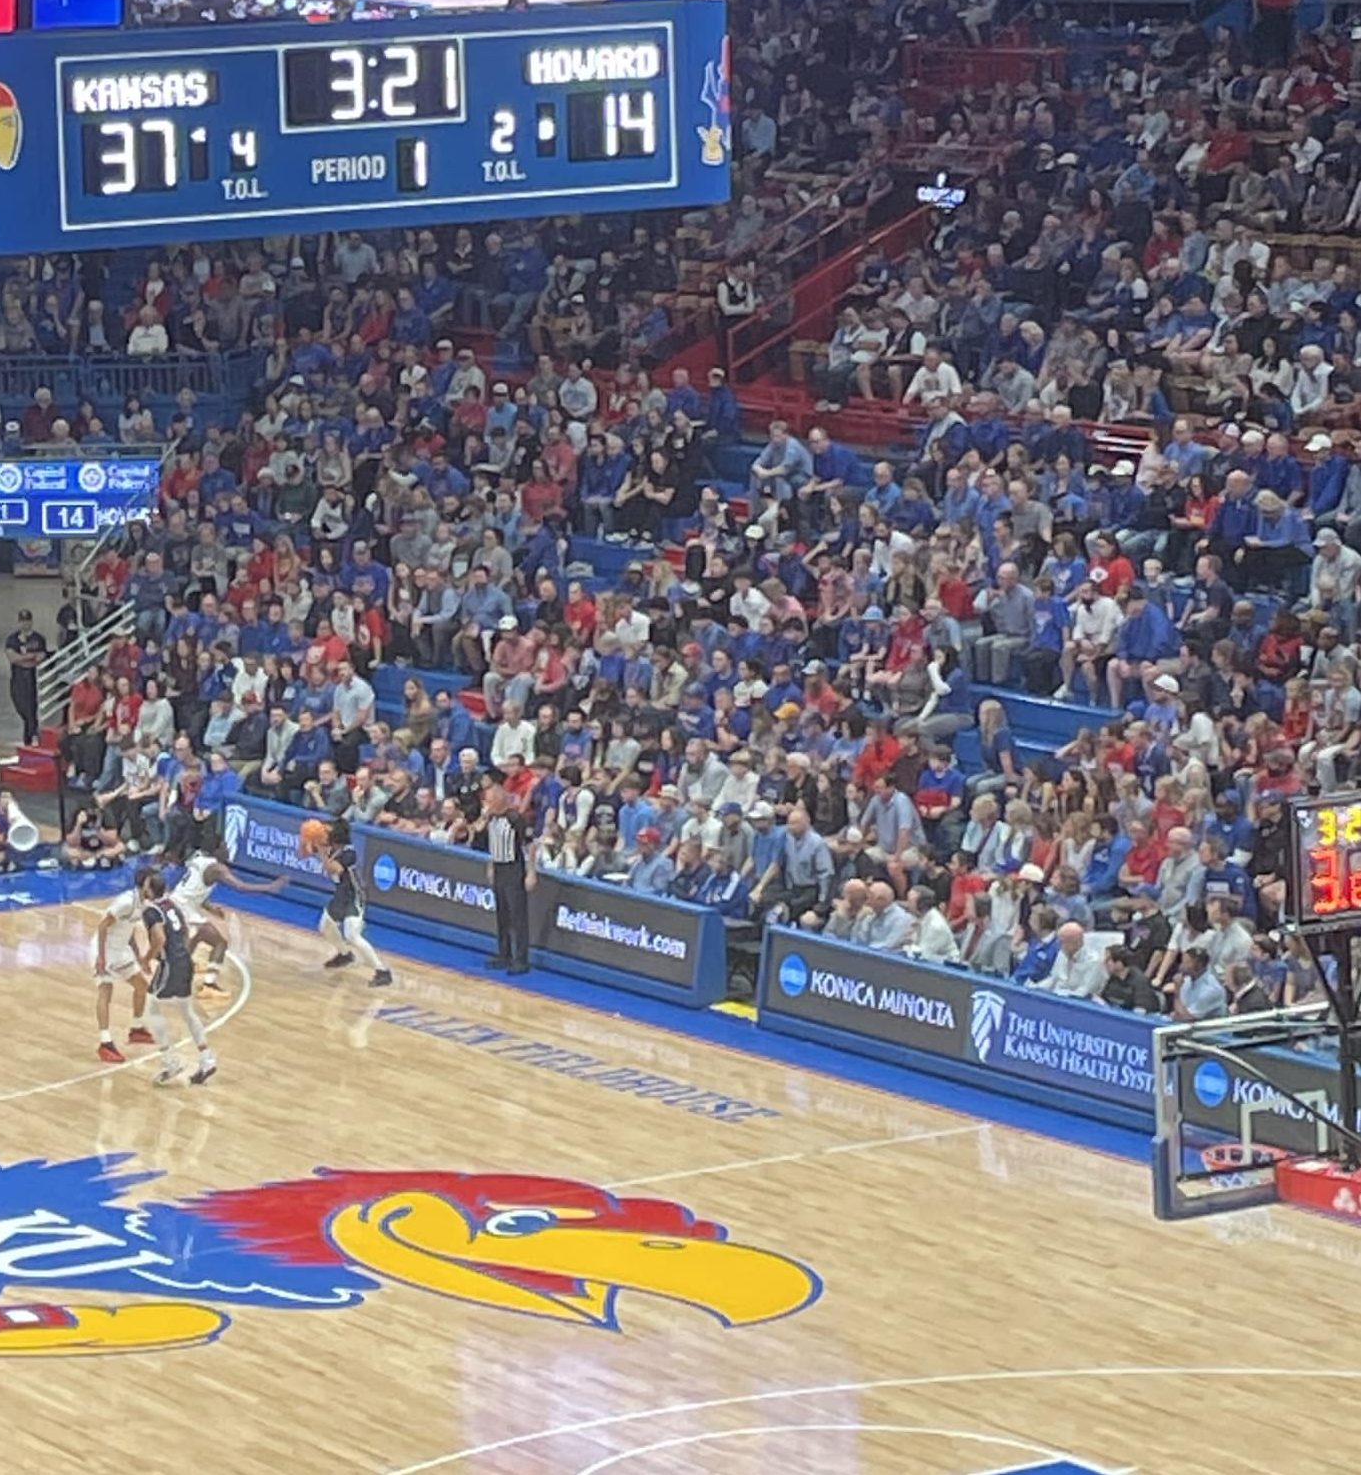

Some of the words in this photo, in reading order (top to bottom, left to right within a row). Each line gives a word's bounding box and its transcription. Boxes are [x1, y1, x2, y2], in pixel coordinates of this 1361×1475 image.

[330, 46, 459, 120] 3:21
[529, 43, 660, 85] HOWARD
[73, 71, 209, 113] KANSAS
[491, 111, 515, 152] 2
[603, 91, 655, 156] 14
[101, 120, 178, 195] 37
[231, 130, 256, 167] 4
[415, 141, 428, 185] 1
[221, 178, 269, 199] T.O.L.
[311, 156, 387, 184] PERIOD
[482, 159, 526, 182] T.O.L.
[58, 506, 85, 529] 14
[398, 868, 451, 901] KONICA
[556, 905, 687, 961] Rethinkwork.com
[809, 970, 877, 1009] KONICA
[879, 987, 956, 1030] MINOLTA
[1006, 1009, 1037, 1039] THE
[1038, 1019, 1125, 1064] UNIVERSITY
[1126, 1041, 1148, 1067] OF
[1003, 1032, 1061, 1074] KANSAS
[1061, 1047, 1119, 1084] HEALTH
[1119, 1062, 1174, 1096] SYST
